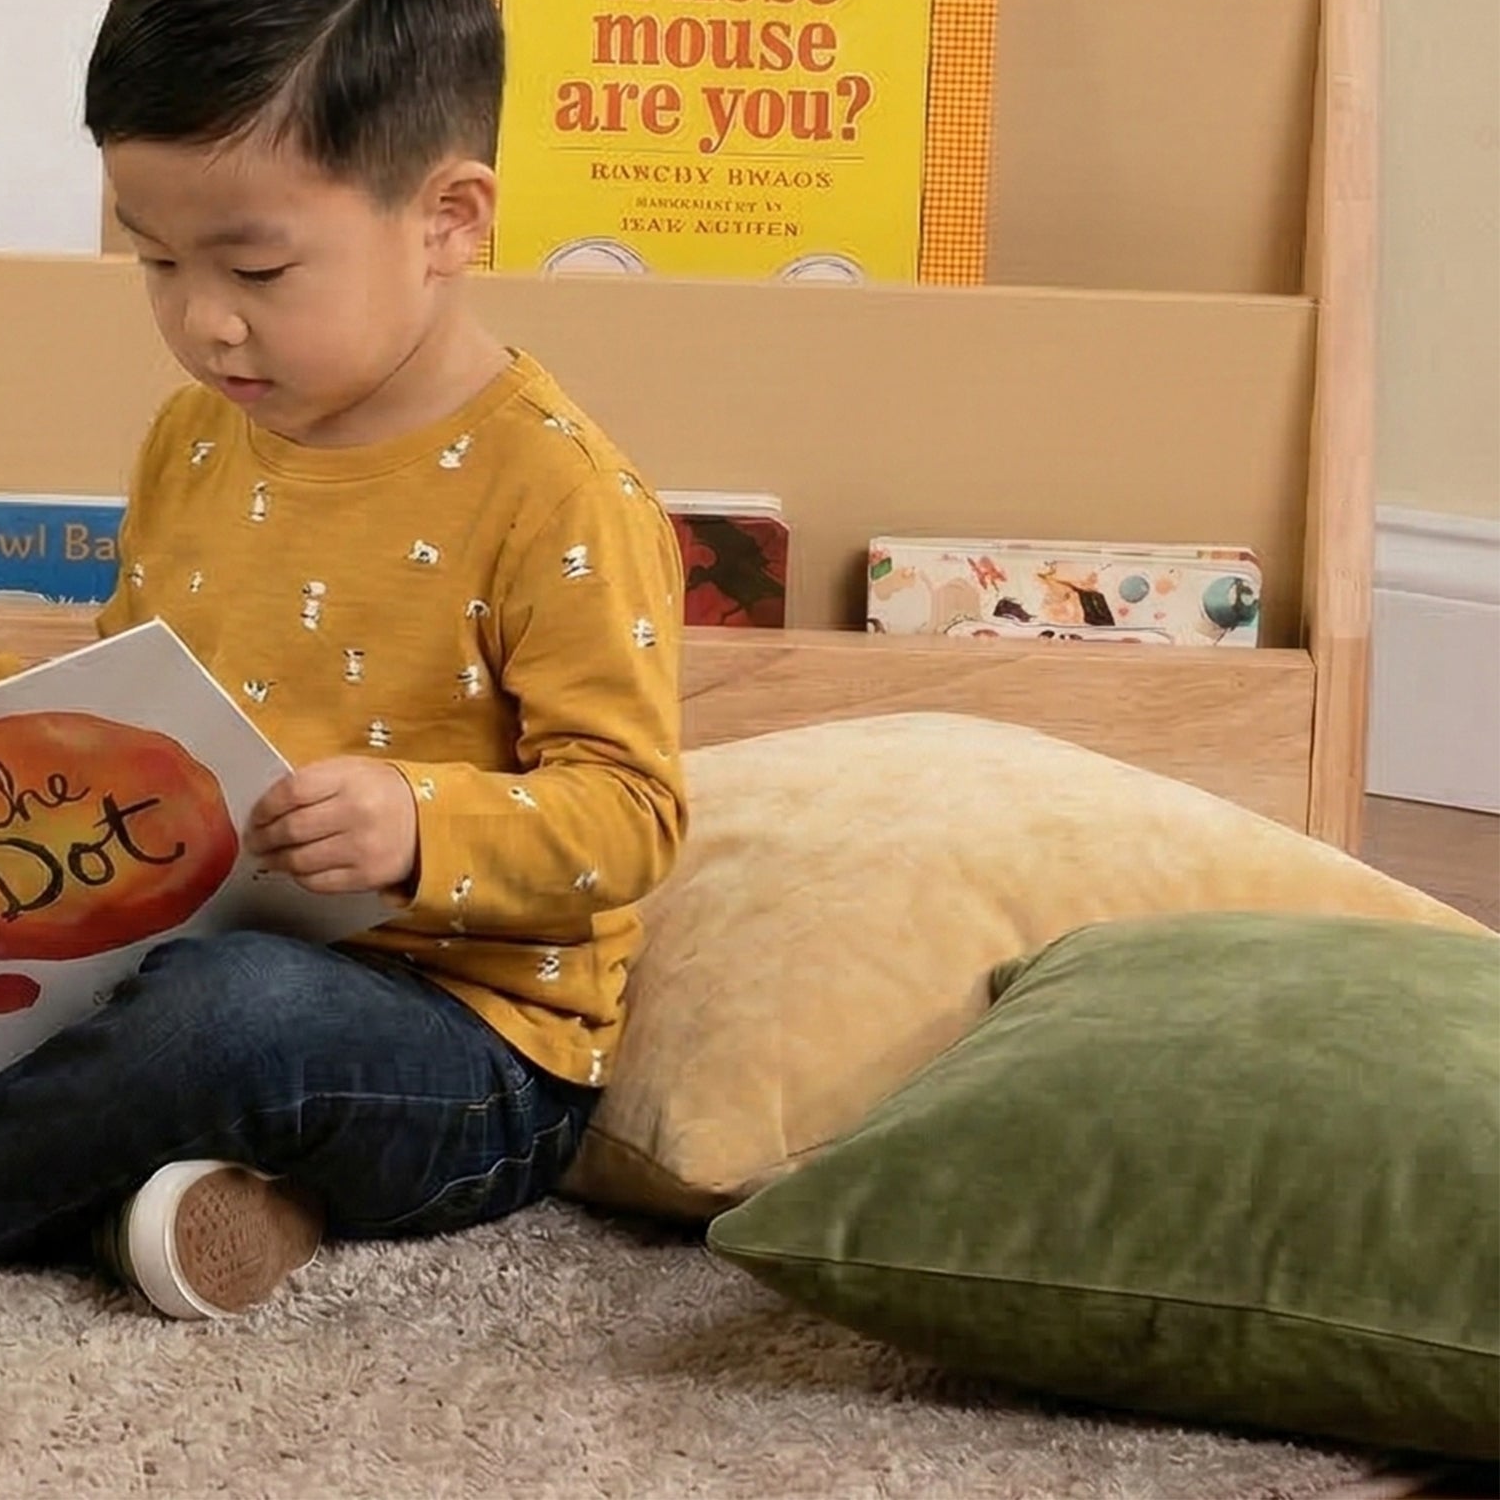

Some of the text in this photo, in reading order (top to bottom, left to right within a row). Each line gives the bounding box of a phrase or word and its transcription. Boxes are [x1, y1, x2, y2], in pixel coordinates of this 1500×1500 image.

[592, 12, 838, 72] mouse
[554, 75, 873, 155] are you?
